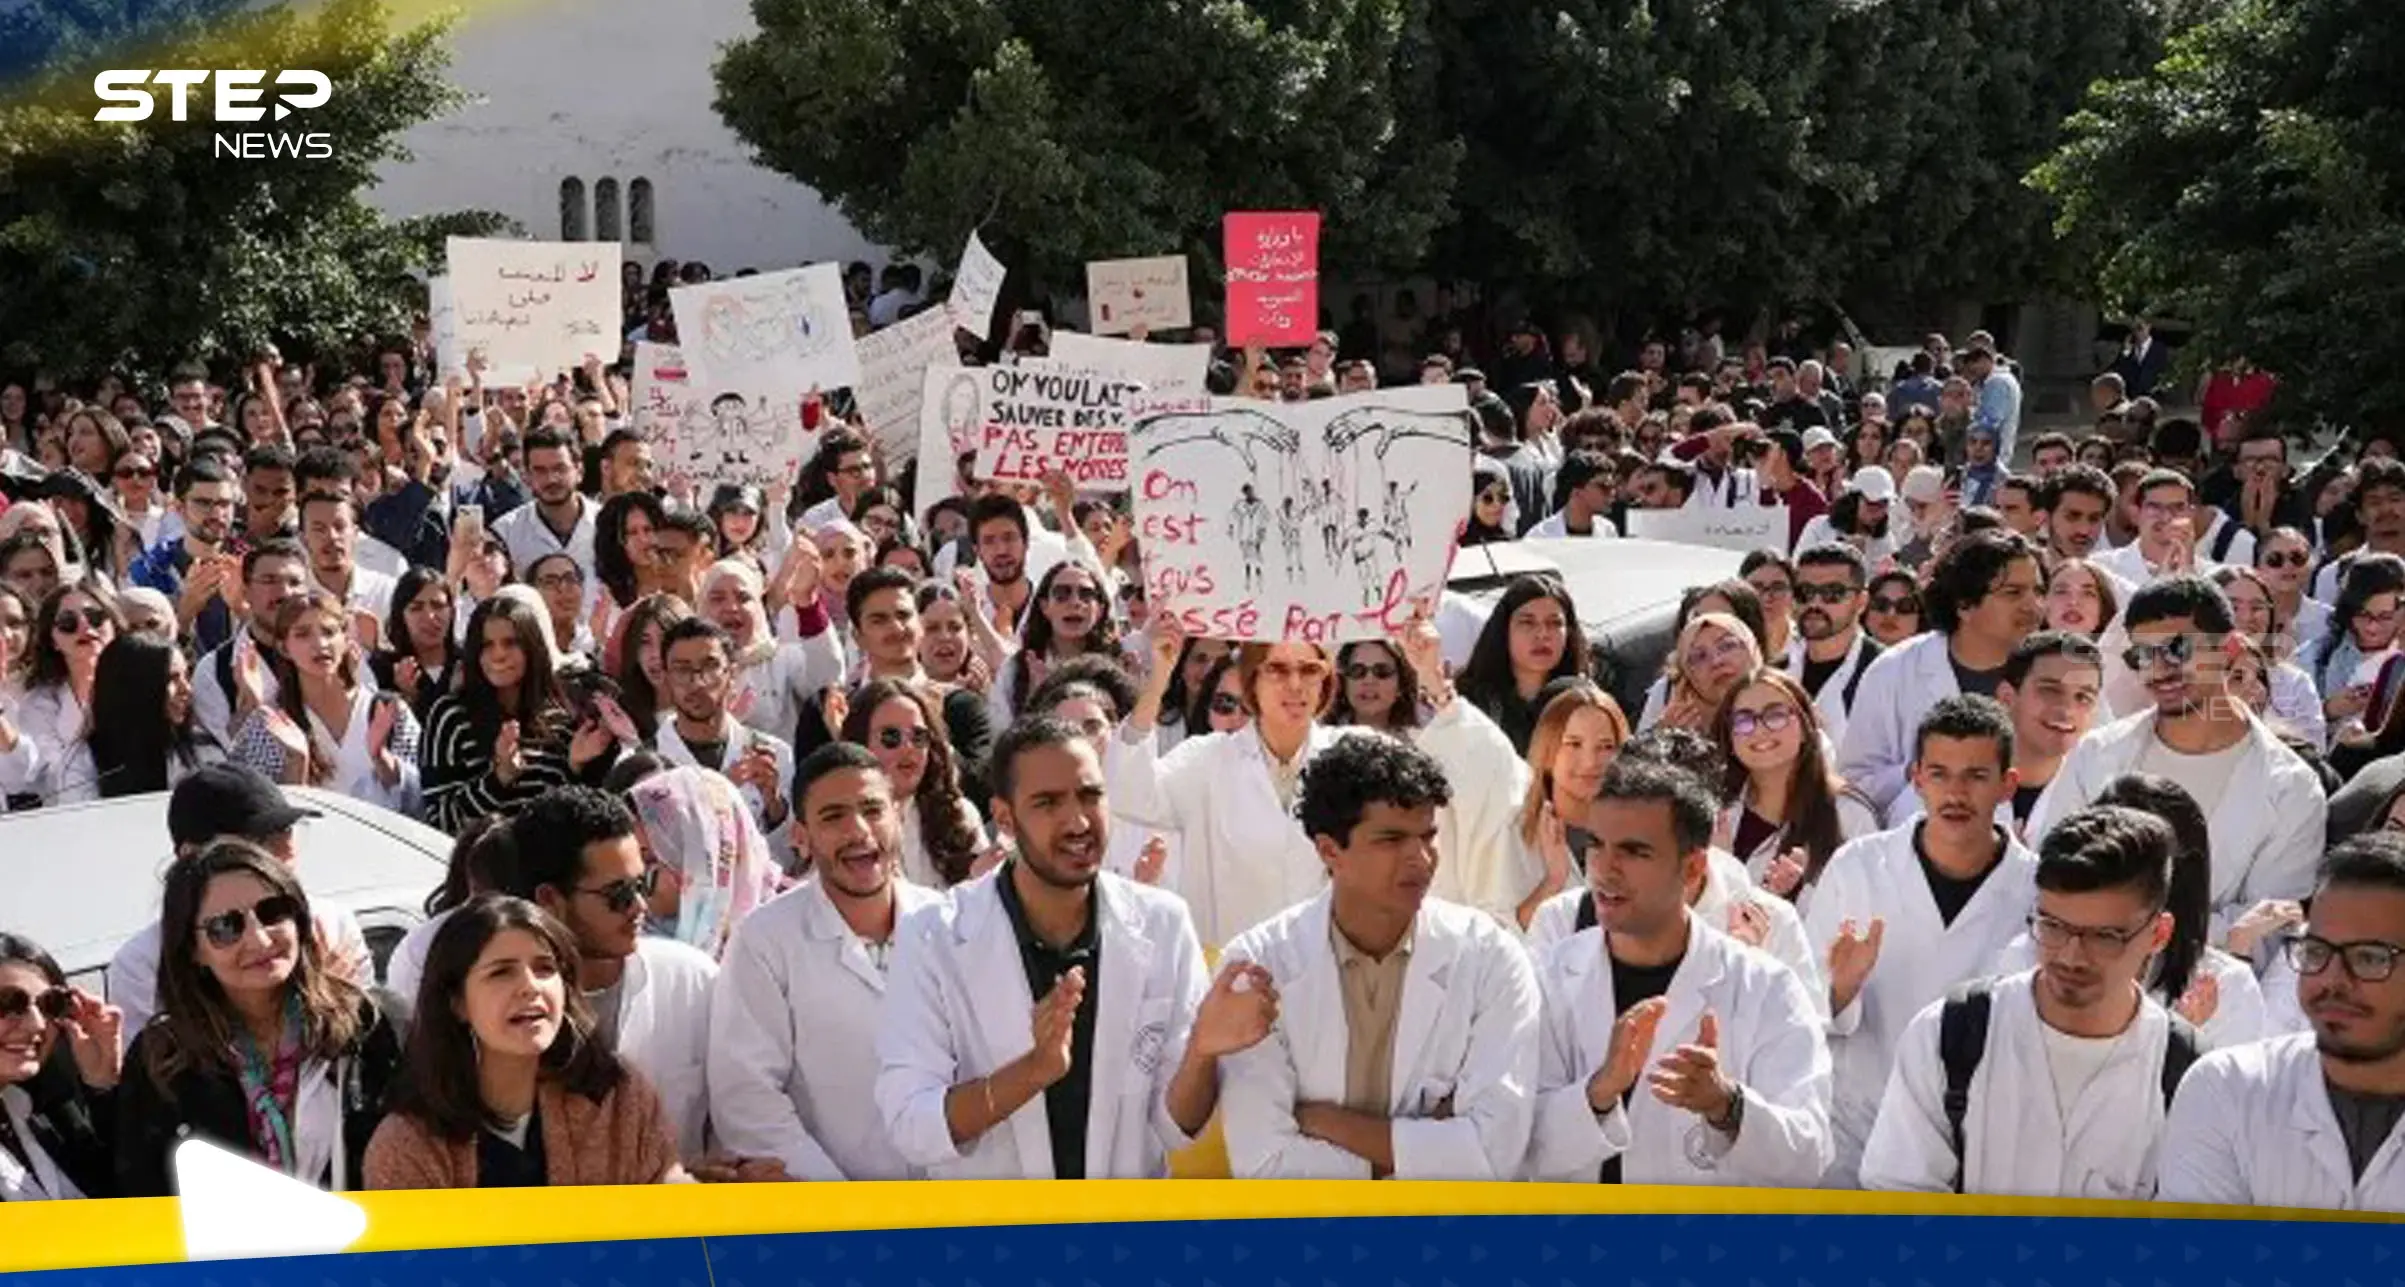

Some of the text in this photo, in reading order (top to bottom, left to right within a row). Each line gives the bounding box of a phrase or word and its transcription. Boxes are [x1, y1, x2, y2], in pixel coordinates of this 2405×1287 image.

[576, 259, 599, 283] لا
[992, 369, 1028, 397] ON
[988, 399, 1065, 427] SAUVER
[983, 426, 1039, 451] PAS
[992, 452, 1049, 479] LES
[1142, 513, 1207, 546] est
